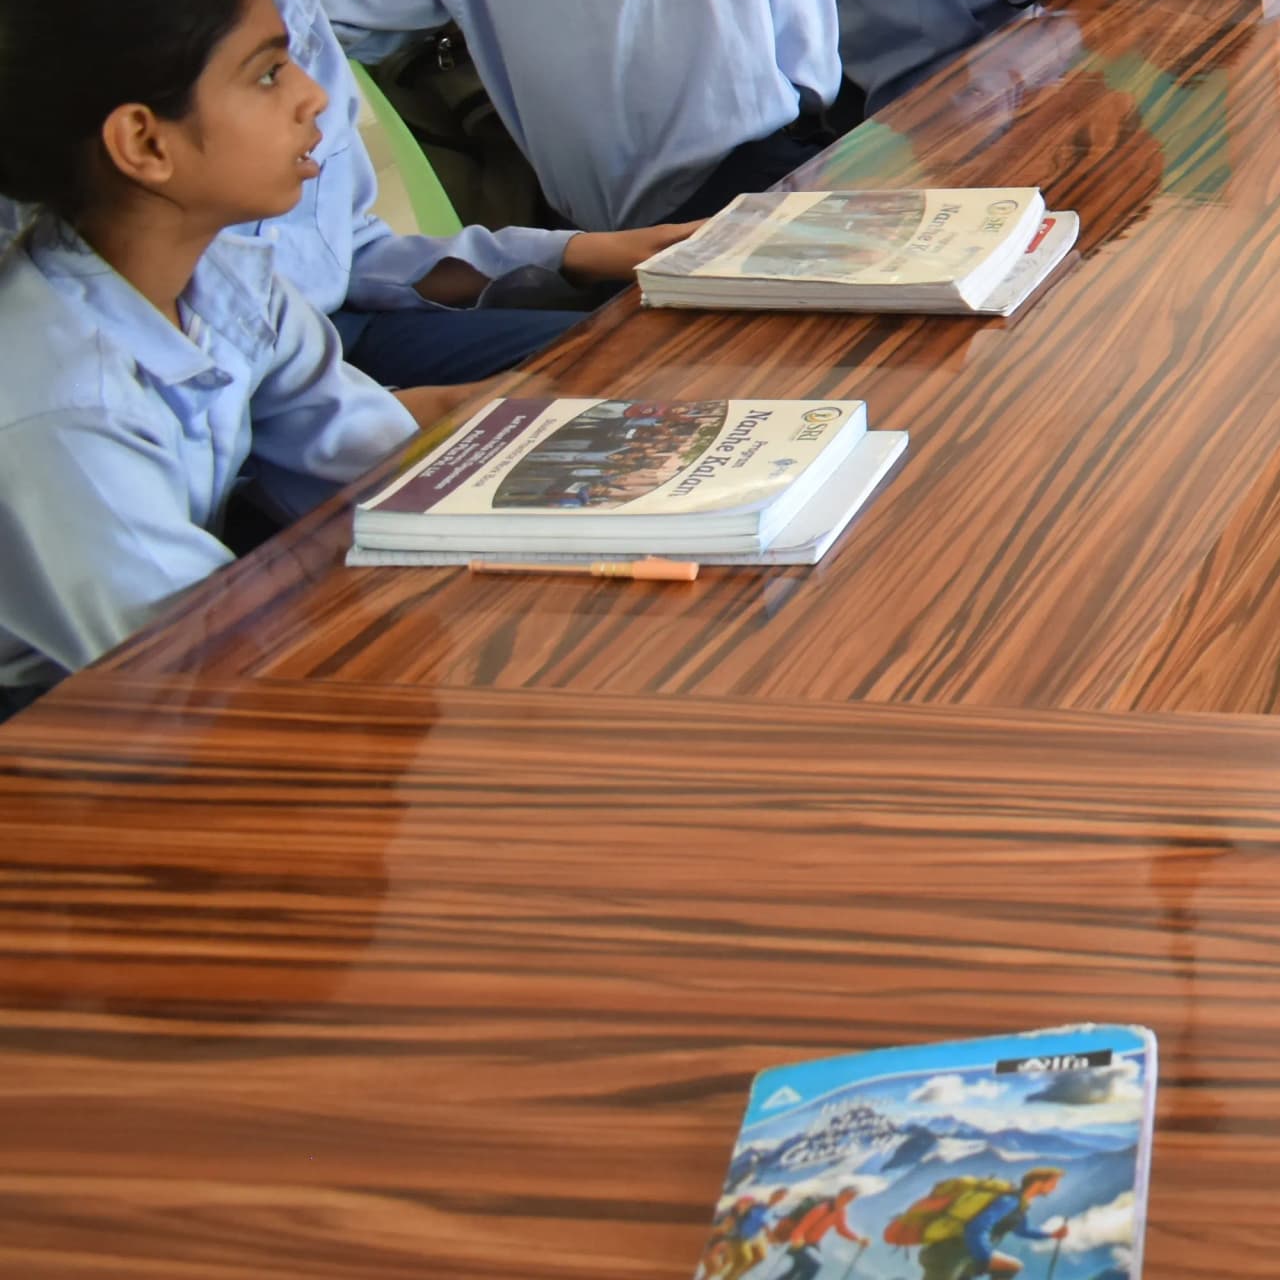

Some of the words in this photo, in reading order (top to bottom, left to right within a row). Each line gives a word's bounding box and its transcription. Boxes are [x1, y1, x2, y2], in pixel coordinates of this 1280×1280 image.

[716, 410, 773, 452] Nanhe
[797, 423, 828, 441] SRI
[731, 440, 768, 468] Program
[668, 455, 731, 497] Kalam
